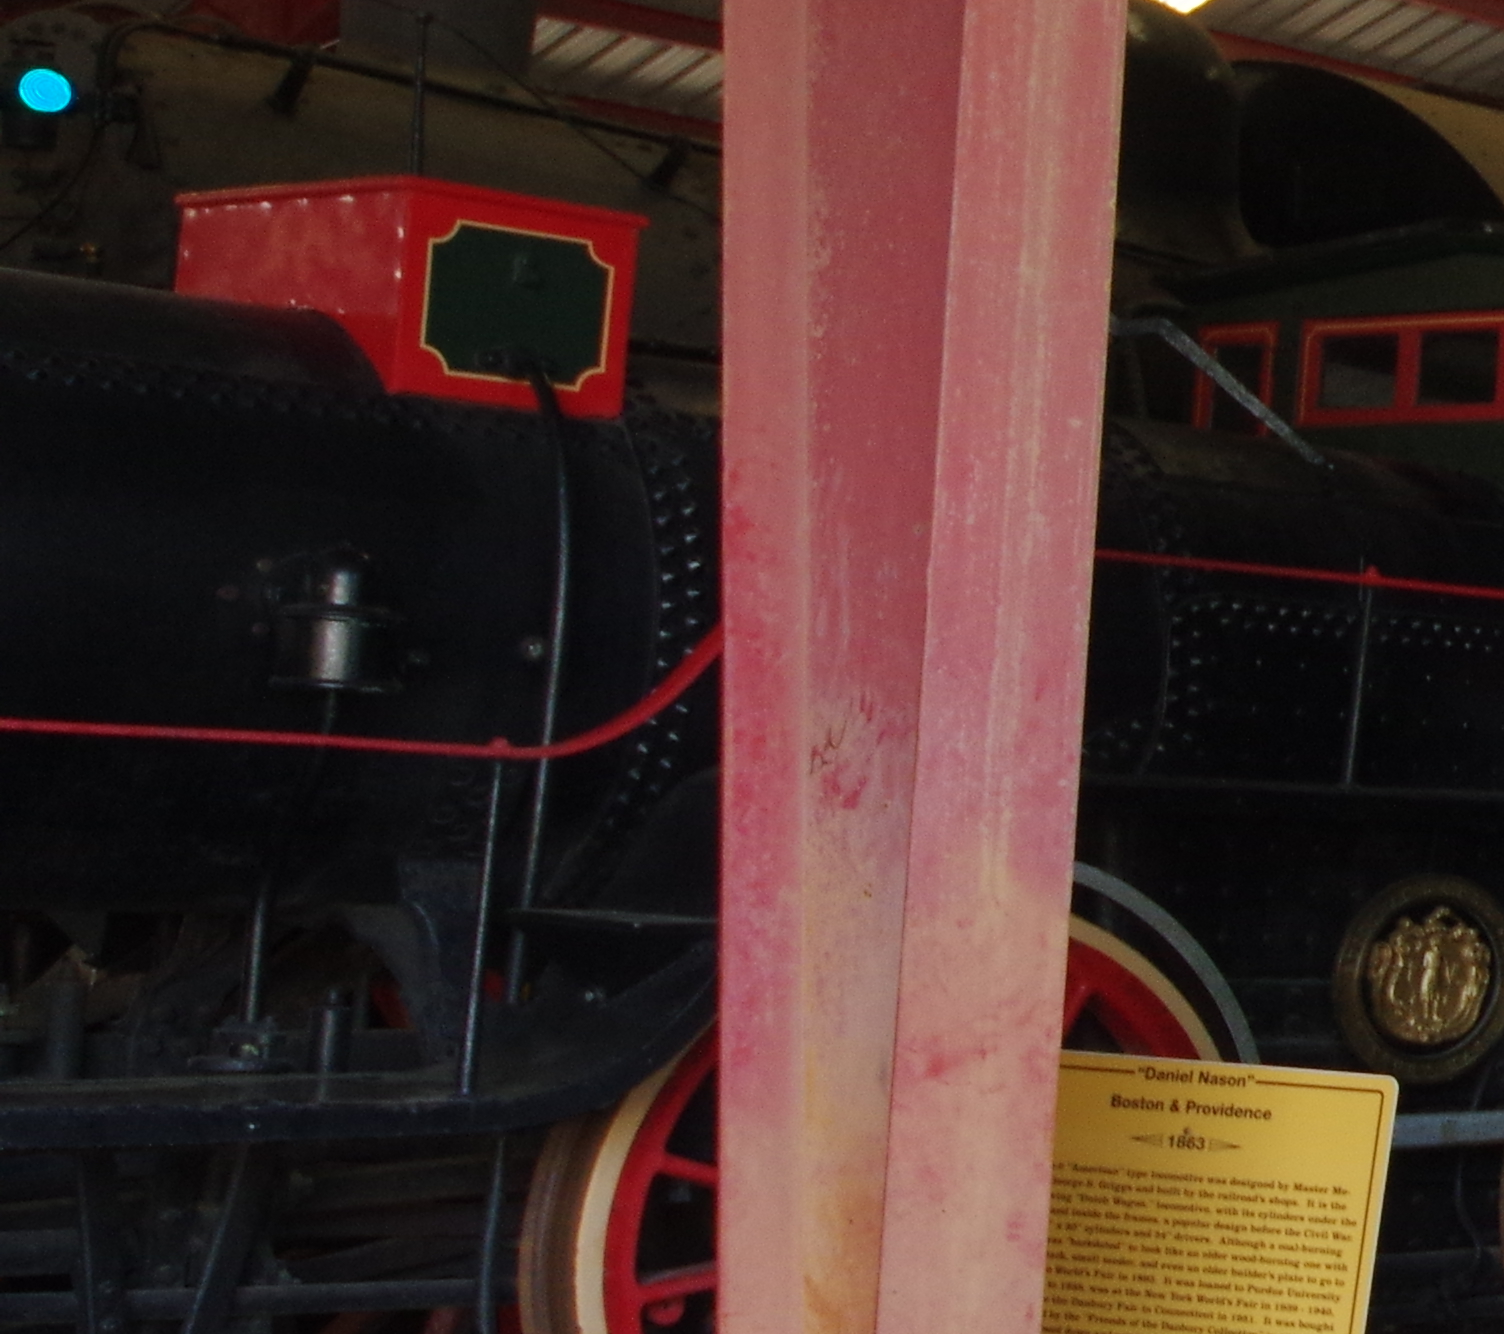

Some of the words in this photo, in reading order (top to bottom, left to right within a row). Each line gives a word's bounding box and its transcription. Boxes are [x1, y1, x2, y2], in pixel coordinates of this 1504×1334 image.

[1137, 1068, 1194, 1084] "Daniel
[1198, 1071, 1255, 1088] Nason"
[1111, 1094, 1165, 1113] Boston
[1169, 1100, 1180, 1113] &
[1185, 1101, 1272, 1120] Providence
[1168, 1135, 1206, 1151] 1863
[1151, 1170, 1204, 1182] locomotive
[1230, 1177, 1275, 1190] designed
[1277, 1181, 1289, 1191] by
[1293, 1182, 1328, 1193] Master
[1136, 1184, 1154, 1193] and
[1197, 1189, 1214, 1198] the
[1307, 1199, 1315, 1207] It
[1318, 1200, 1327, 1208] is
[1331, 1201, 1347, 1210] the
[1105, 1211, 1120, 1220] the
[1172, 1217, 1210, 1230] popular
[1214, 1221, 1247, 1233] design
[1251, 1224, 1281, 1234] before
[1285, 1227, 1300, 1236] the
[1304, 1229, 1328, 1239] Civil
[1216, 1206, 1238, 1216] with
[1242, 1208, 1255, 1217] its
[1258, 1210, 1305, 1223] cylinders
[1308, 1214, 1336, 1224] under
[1341, 1217, 1357, 1226] the
[1134, 1229, 1152, 1238] and
[1220, 1236, 1266, 1250] Although
[1165, 1246, 1184, 1256] like
[1203, 1250, 1227, 1260] older
[1325, 1261, 1348, 1271] with
[1140, 1259, 1158, 1268] and
[1161, 1263, 1184, 1271] even
[1203, 1265, 1227, 1275] older
[1231, 1268, 1275, 1279] builder's
[1278, 1272, 1303, 1284] plate
[1307, 1275, 1317, 1283] to
[1320, 1277, 1331, 1286] go
[1335, 1277, 1345, 1286] to
[1125, 1288, 1141, 1297] the
[1144, 1289, 1166, 1299] New
[1171, 1292, 1192, 1302] York
[1197, 1295, 1233, 1305] World's
[1236, 1298, 1257, 1308] Fair
[1261, 1301, 1271, 1309] in
[1164, 1276, 1172, 1284] It
[1176, 1279, 1195, 1287] was
[1198, 1280, 1231, 1290] loaned
[1235, 1283, 1244, 1291] to
[1247, 1284, 1283, 1295] Purdue
[1287, 1288, 1341, 1302] University
[1130, 1318, 1139, 1327] of
[1142, 1319, 1157, 1328] the
[1161, 1321, 1203, 1334] Danbury
[1218, 1312, 1227, 1320] in
[1264, 1316, 1272, 1325] It
[1276, 1319, 1295, 1327] was
[1298, 1320, 1334, 1332] bought
